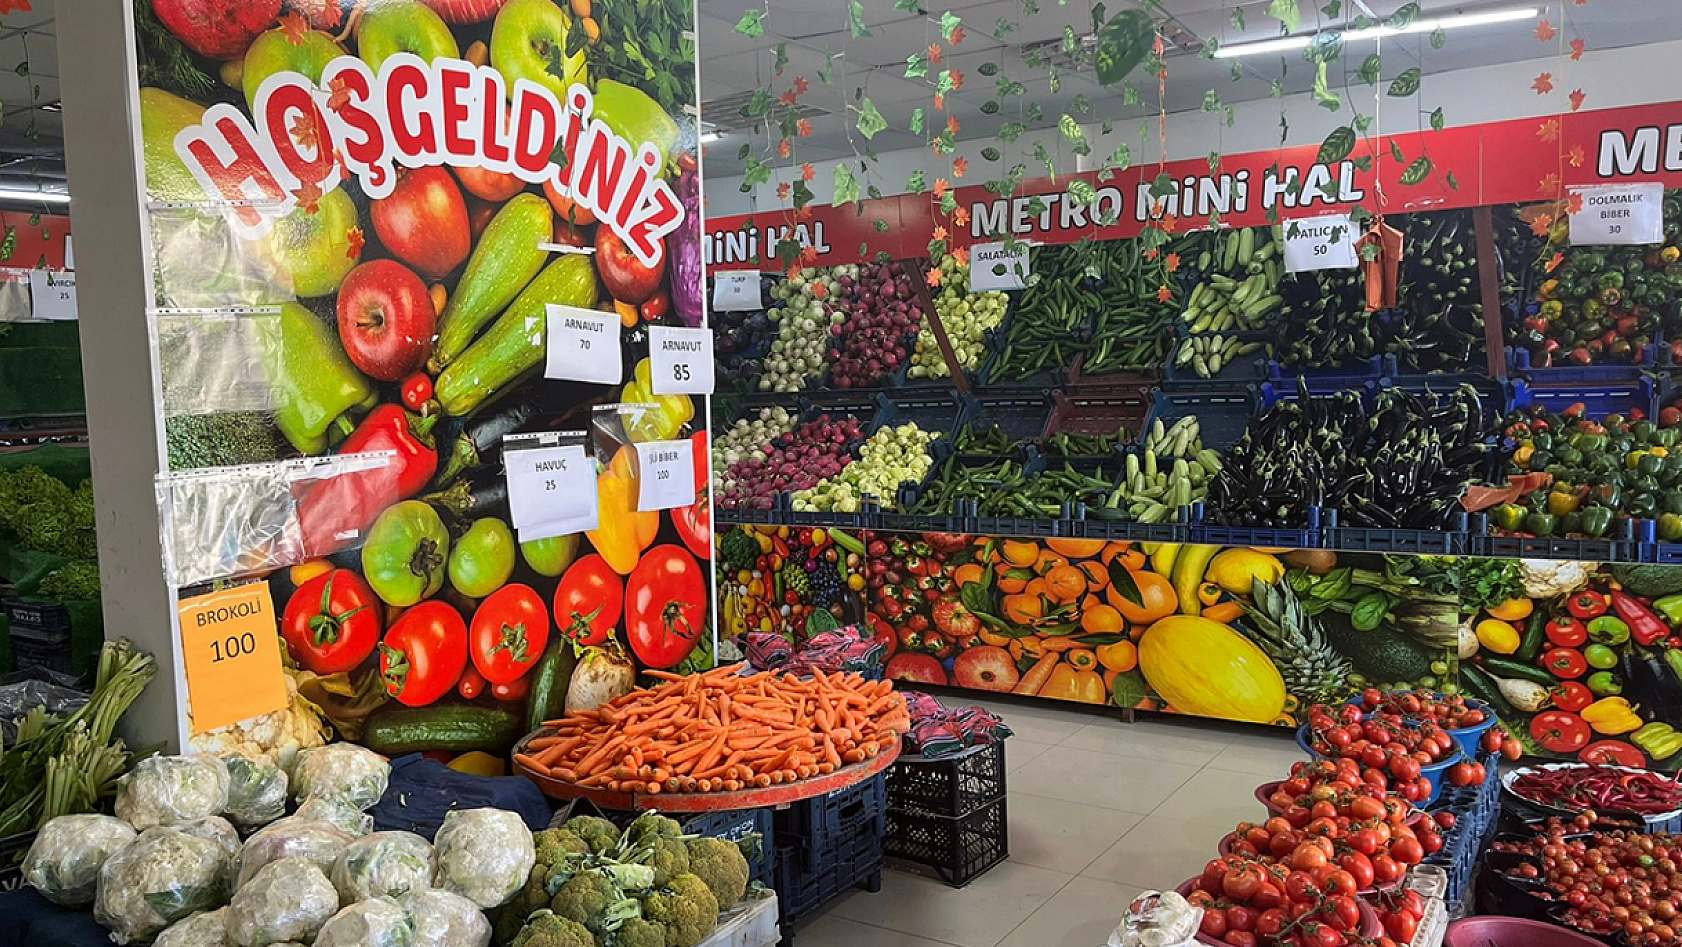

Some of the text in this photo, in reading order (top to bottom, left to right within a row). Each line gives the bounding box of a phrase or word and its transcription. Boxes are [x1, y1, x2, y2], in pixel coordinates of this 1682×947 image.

[186, 62, 681, 260] HOŞGELDİNİZ
[970, 186, 1123, 238] METRO
[1261, 160, 1365, 210] HAL
[1588, 194, 1643, 206] DOLMALIK
[1293, 225, 1349, 240] PATLICN
[1608, 224, 1622, 234] 30
[1314, 244, 1328, 256] 50
[564, 318, 605, 333] ARNAVUT
[579, 339, 591, 349] 70
[662, 340, 703, 352] ARNAVUT
[673, 364, 691, 381] 85
[535, 459, 568, 472] HAVUÇ
[545, 480, 556, 491] 25
[196, 597, 262, 627] BROKOLİ
[210, 631, 256, 663] 100
